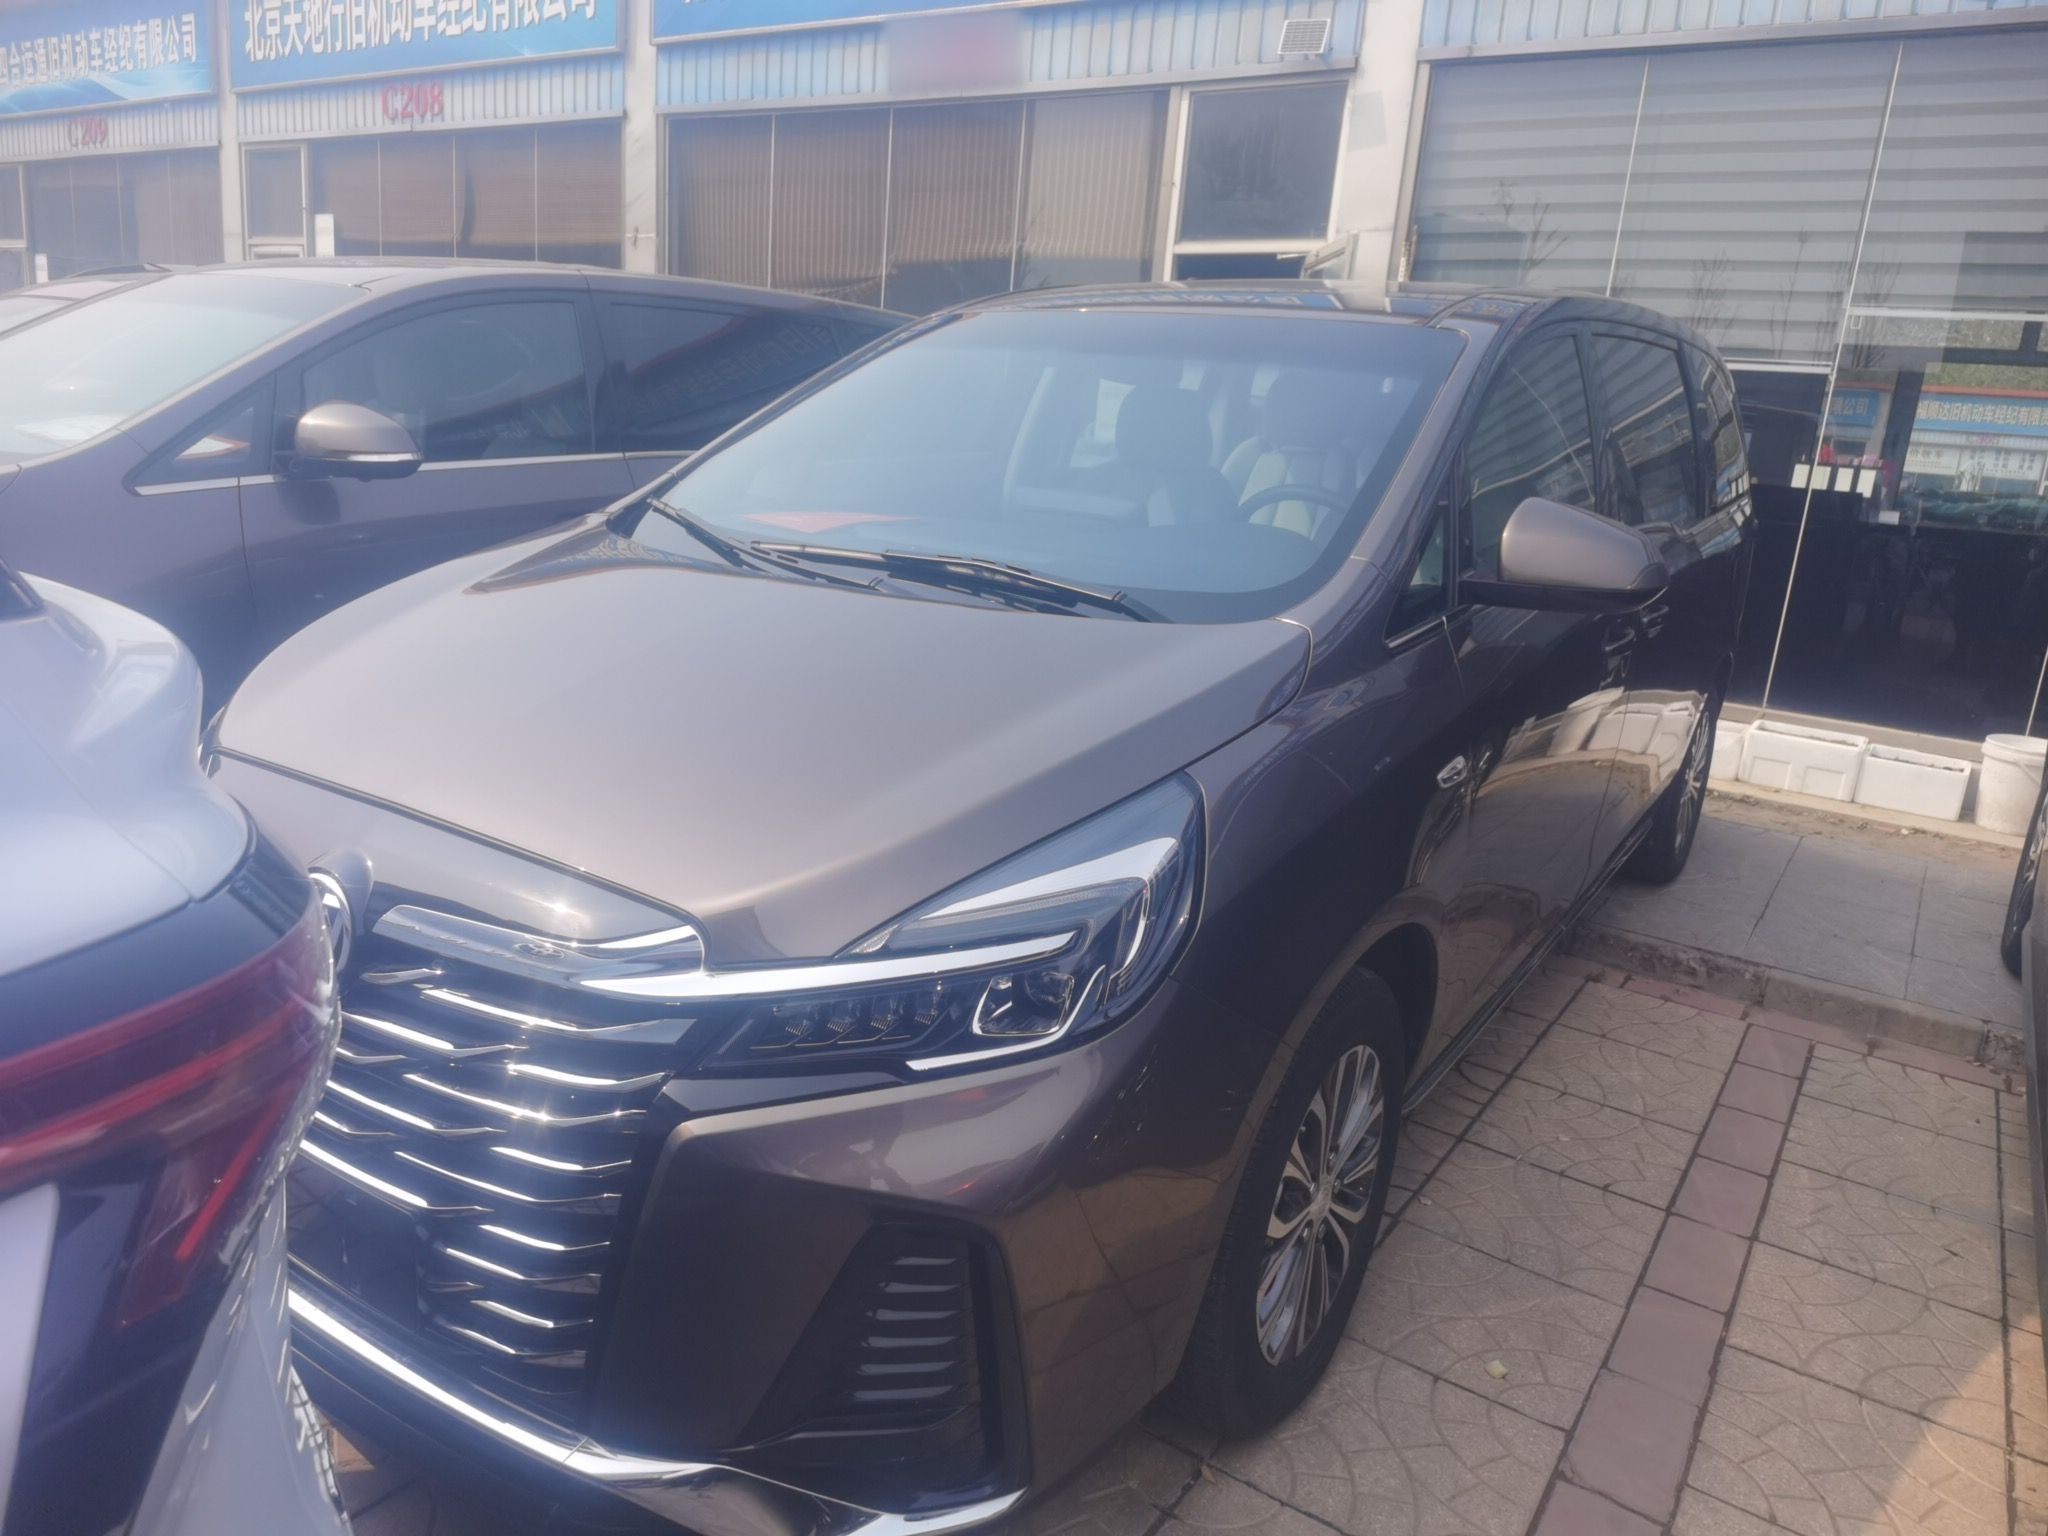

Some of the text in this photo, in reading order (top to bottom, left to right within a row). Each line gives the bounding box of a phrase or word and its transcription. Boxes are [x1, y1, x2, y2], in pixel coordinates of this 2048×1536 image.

[244, 0, 596, 62] 北京天地行旧机动车经
[382, 80, 444, 120] C208
